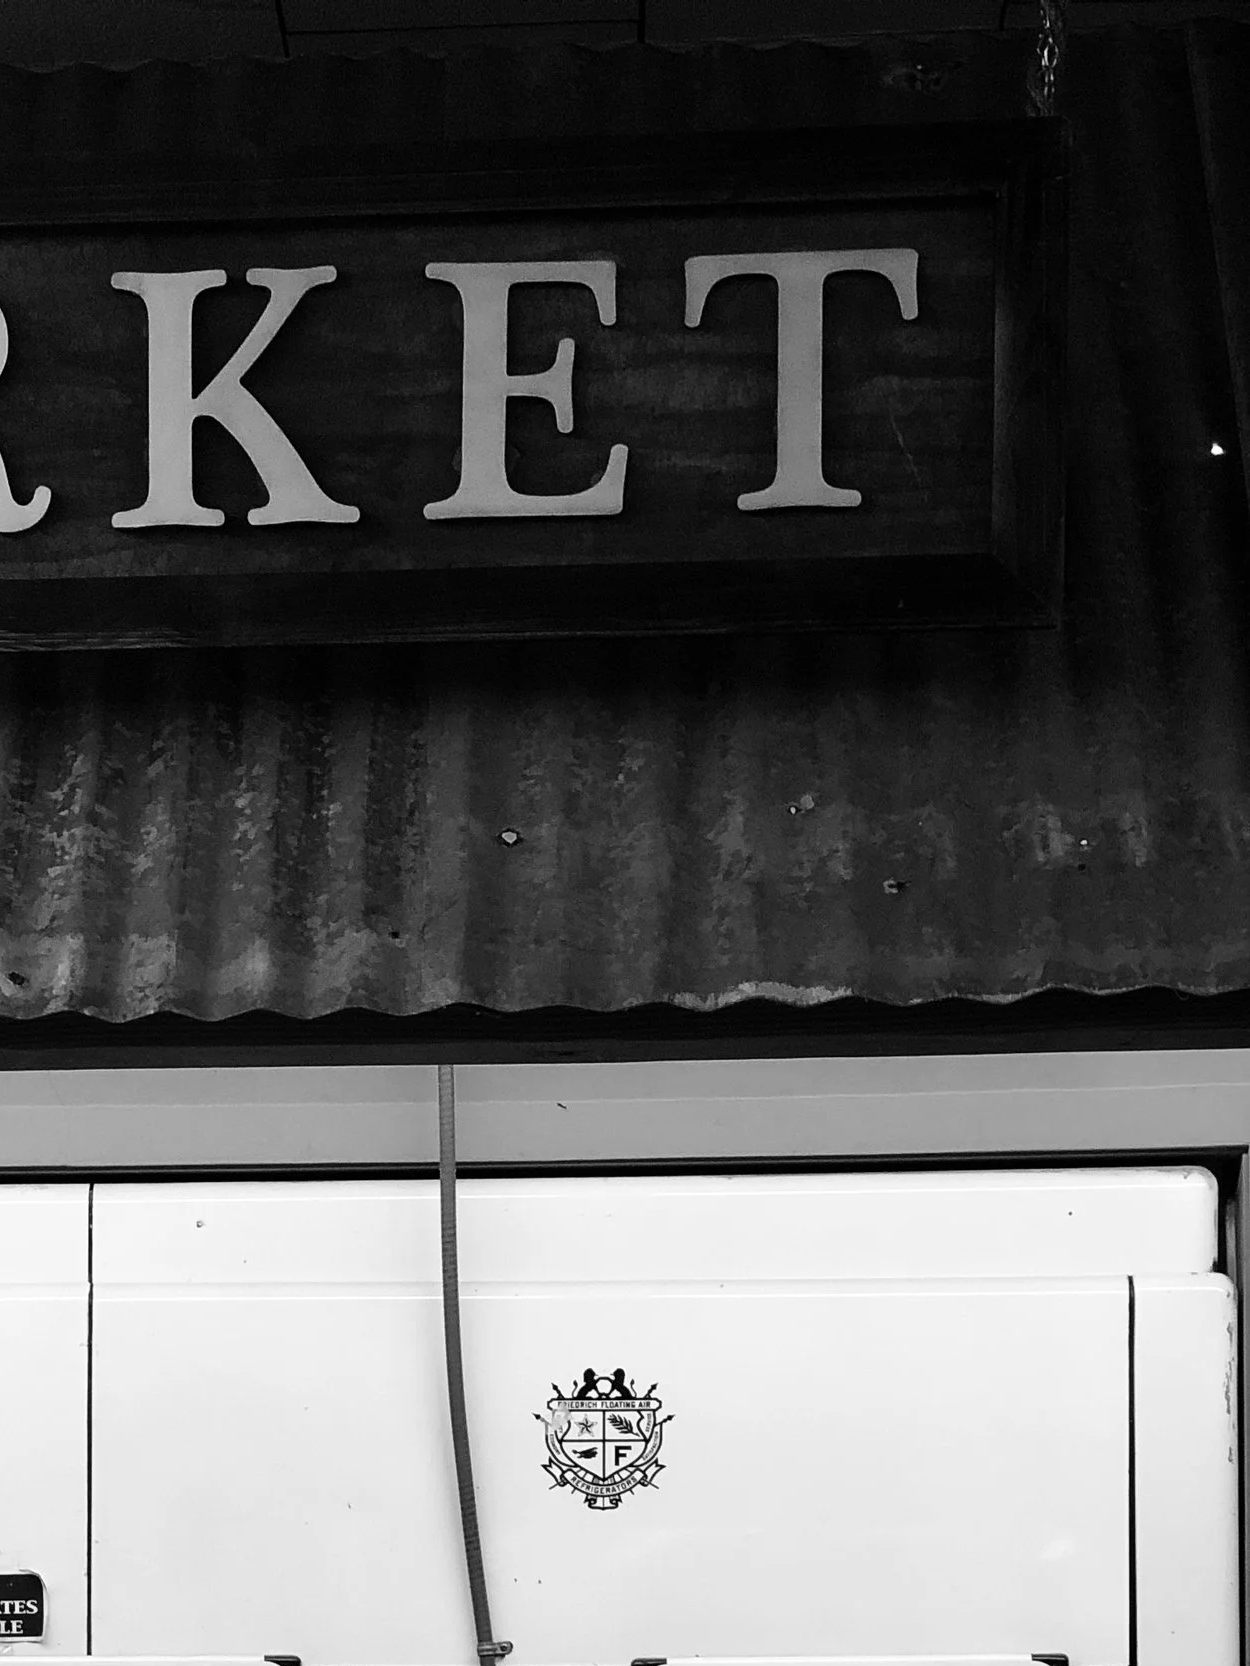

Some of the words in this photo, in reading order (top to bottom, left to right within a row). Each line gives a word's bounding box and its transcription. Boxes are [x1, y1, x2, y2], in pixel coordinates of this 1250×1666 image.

[601, 1401, 636, 1409] FLOATING
[638, 1401, 651, 1409] AIR
[614, 1445, 632, 1466] F
[570, 1475, 638, 1495] REFRIGERATORS
